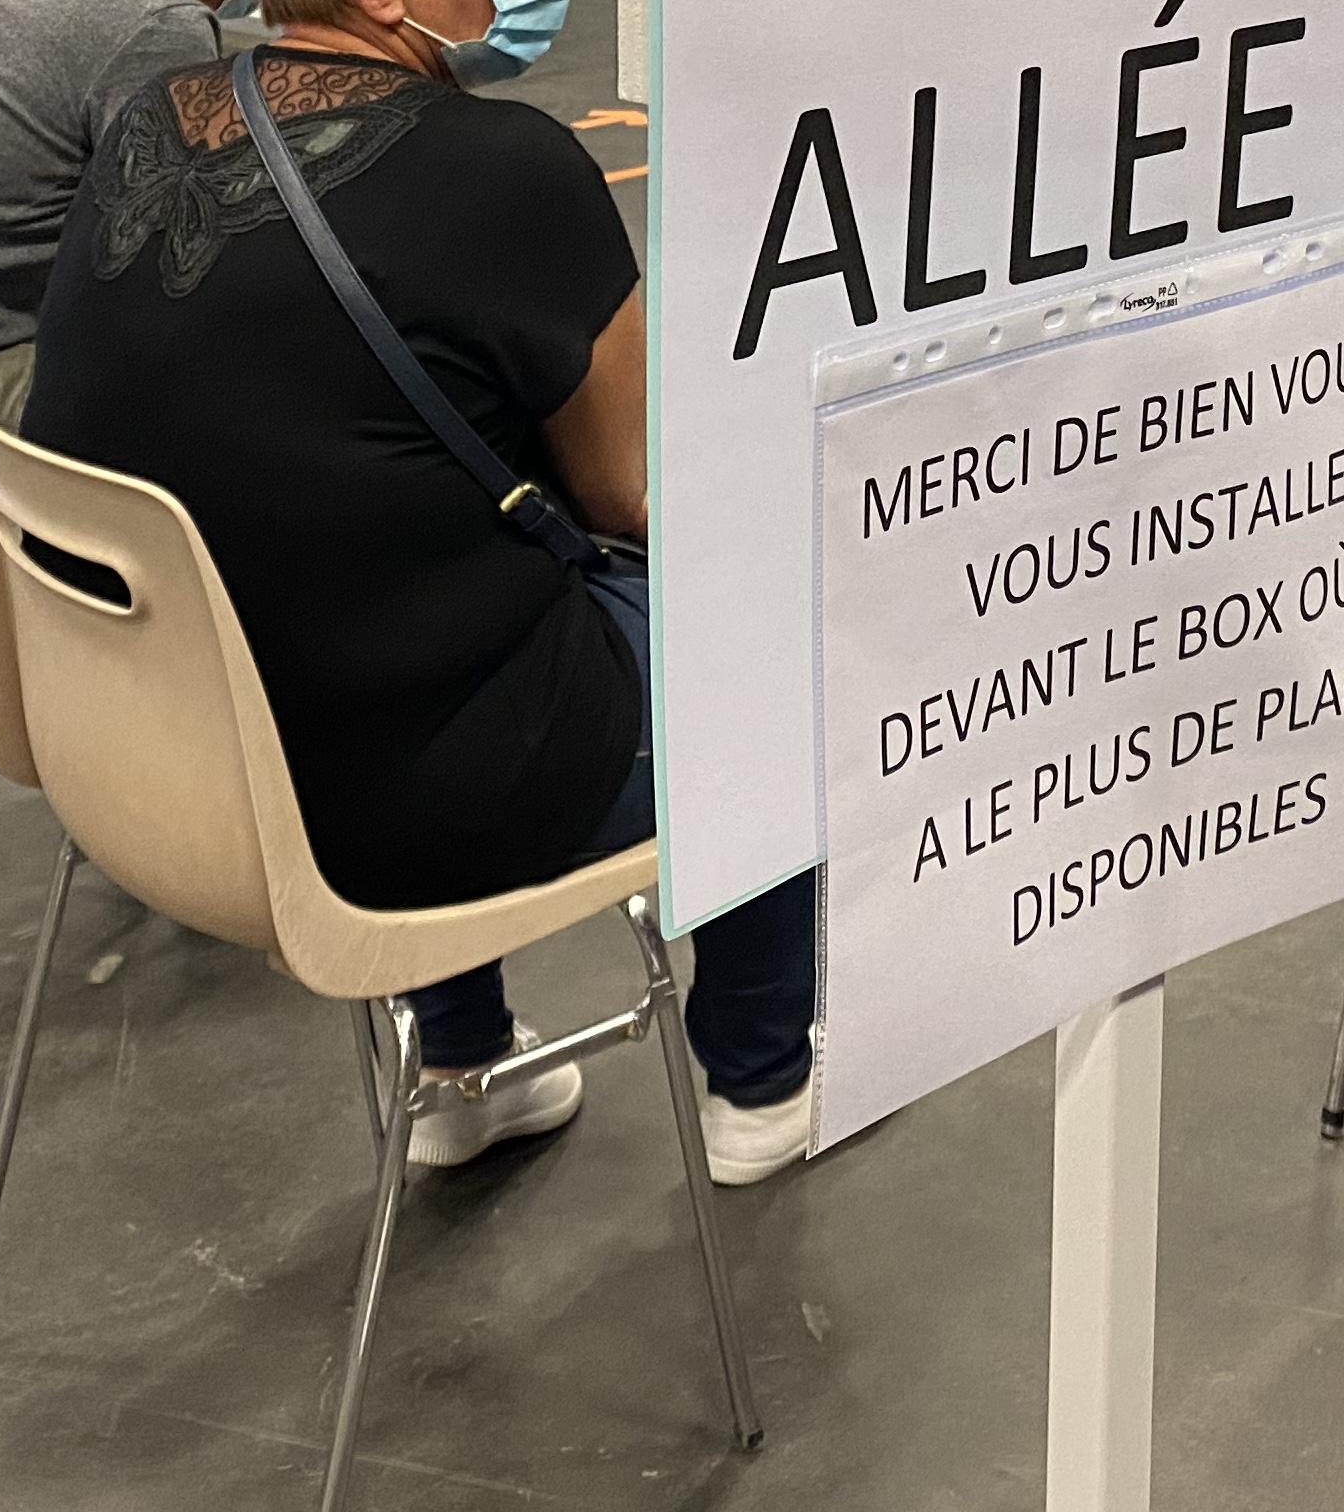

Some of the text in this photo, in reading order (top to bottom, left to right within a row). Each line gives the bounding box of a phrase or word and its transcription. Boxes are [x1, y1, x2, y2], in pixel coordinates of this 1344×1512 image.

[864, 428, 1029, 538] MERCI
[1054, 406, 1120, 475] DE
[1141, 371, 1253, 452] BIEN
[966, 520, 1110, 616] VOUS
[882, 638, 1087, 776] DEVANT
[1105, 616, 1157, 682] LE
[1179, 581, 1283, 660] BOX
[914, 817, 946, 882] A
[966, 780, 1012, 855] LE
[1034, 726, 1150, 823] PLUS
[1172, 699, 1237, 767] DE
[1014, 773, 1326, 945] DISPONIBLES
